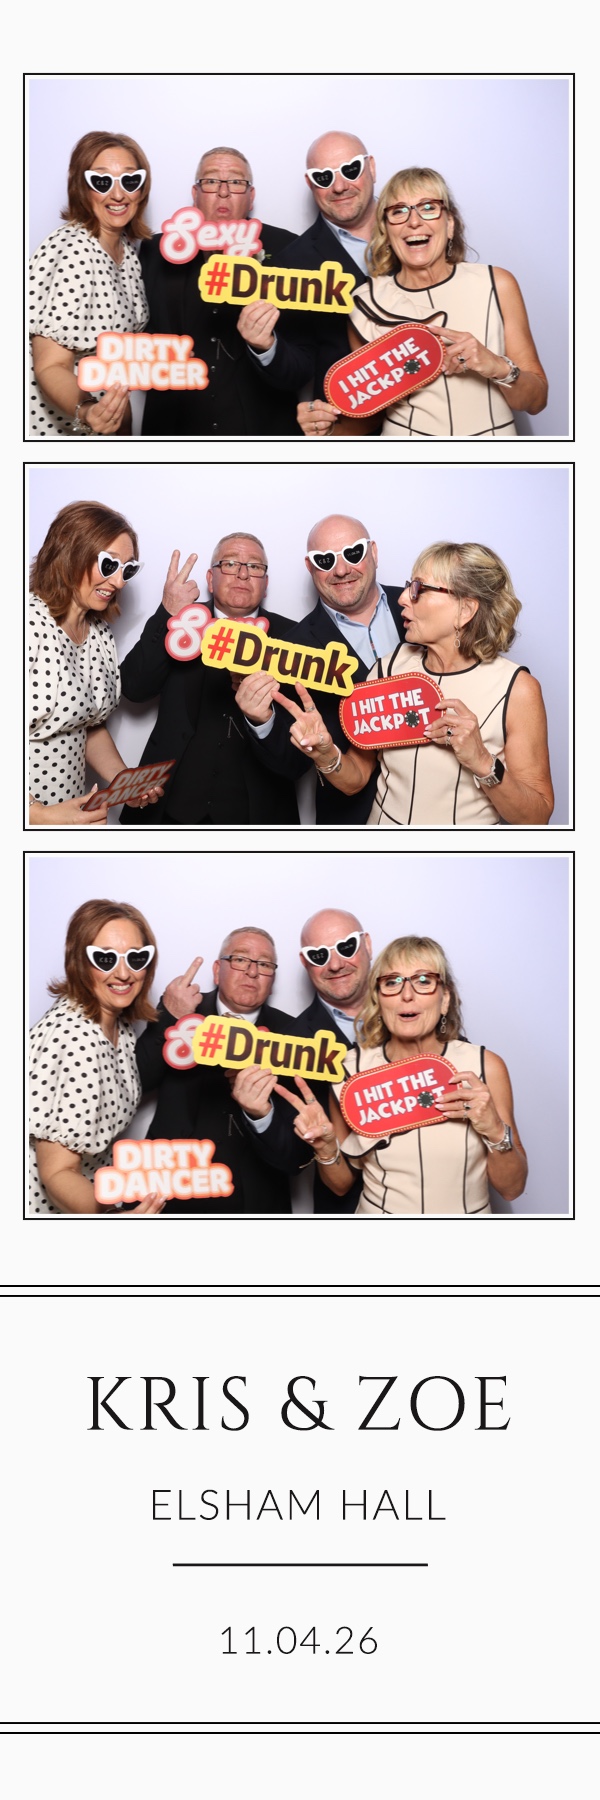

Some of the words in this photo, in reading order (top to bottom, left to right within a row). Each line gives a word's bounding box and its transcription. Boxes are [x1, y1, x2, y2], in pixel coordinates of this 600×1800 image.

[163, 210, 260, 261] Sexy
[205, 262, 349, 307] #Drunk
[101, 336, 191, 361] DIRTY
[338, 380, 350, 394] I
[346, 360, 379, 388] HIT
[379, 337, 420, 367] THE
[83, 361, 206, 387] DANCER
[207, 627, 352, 689] #Drunk
[351, 702, 358, 717] I
[359, 695, 385, 715] HIT
[388, 688, 424, 710] THE
[112, 762, 173, 790] DIRTY
[199, 1023, 341, 1075] #Drunk
[353, 1092, 363, 1107] I
[363, 1080, 394, 1104] HIT
[396, 1068, 438, 1093] THE
[117, 1143, 213, 1170] DIRTY
[99, 1167, 230, 1199] DANCER
